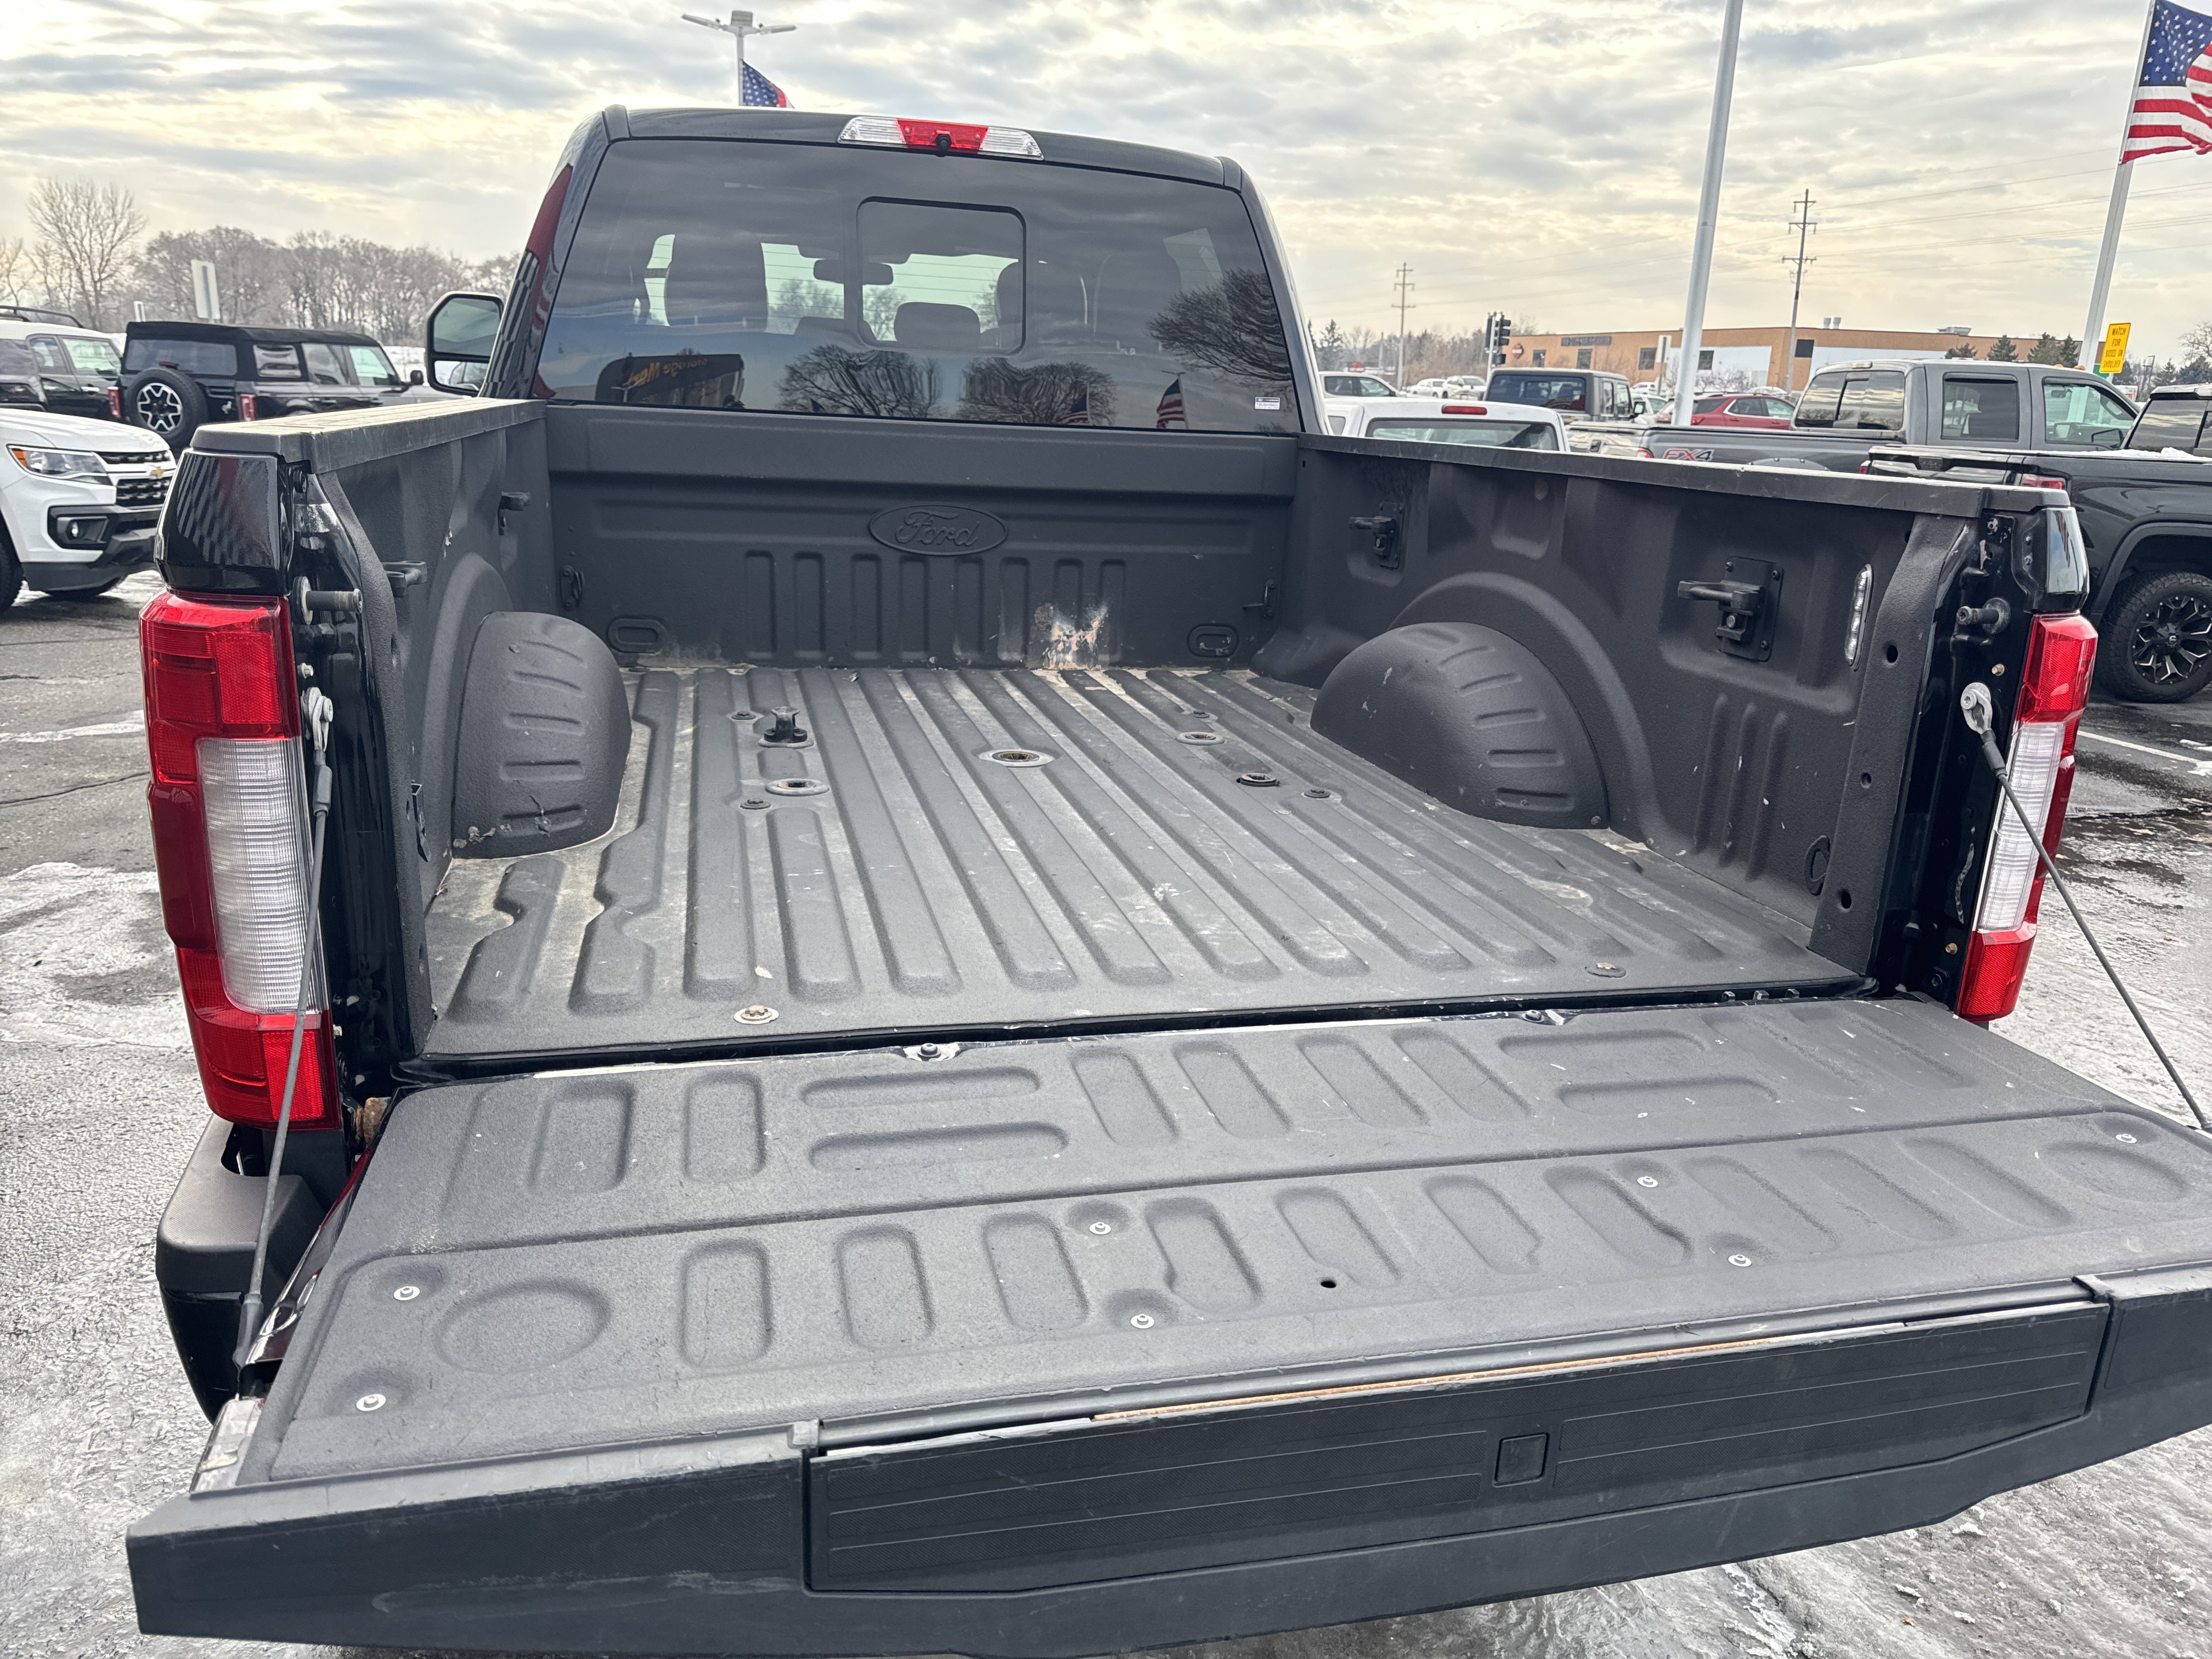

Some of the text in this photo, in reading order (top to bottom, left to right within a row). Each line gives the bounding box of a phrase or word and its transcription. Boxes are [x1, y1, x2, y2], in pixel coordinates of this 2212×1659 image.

[2112, 327, 2126, 335] WATCH
[1663, 448, 1714, 461] FX4
[895, 508, 980, 546] Ford
